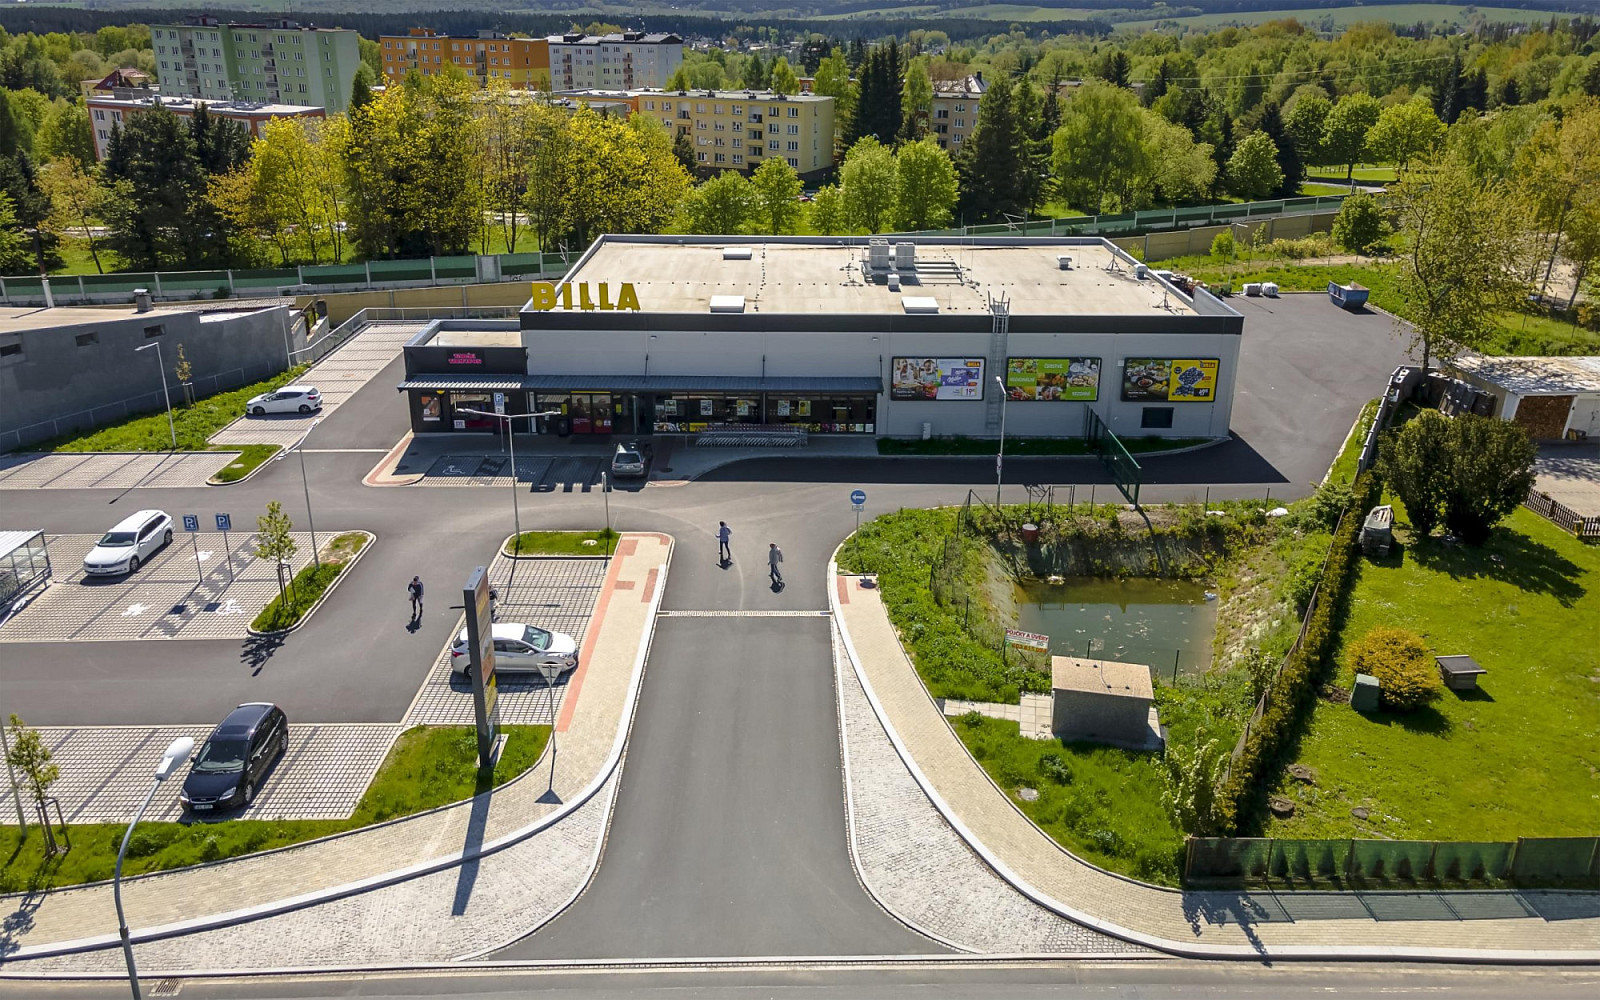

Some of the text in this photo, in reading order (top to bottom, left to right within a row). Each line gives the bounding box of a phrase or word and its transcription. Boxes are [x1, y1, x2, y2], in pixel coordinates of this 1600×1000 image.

[531, 282, 641, 310] BILLA
[186, 518, 193, 527] P
[218, 516, 225, 526] P
